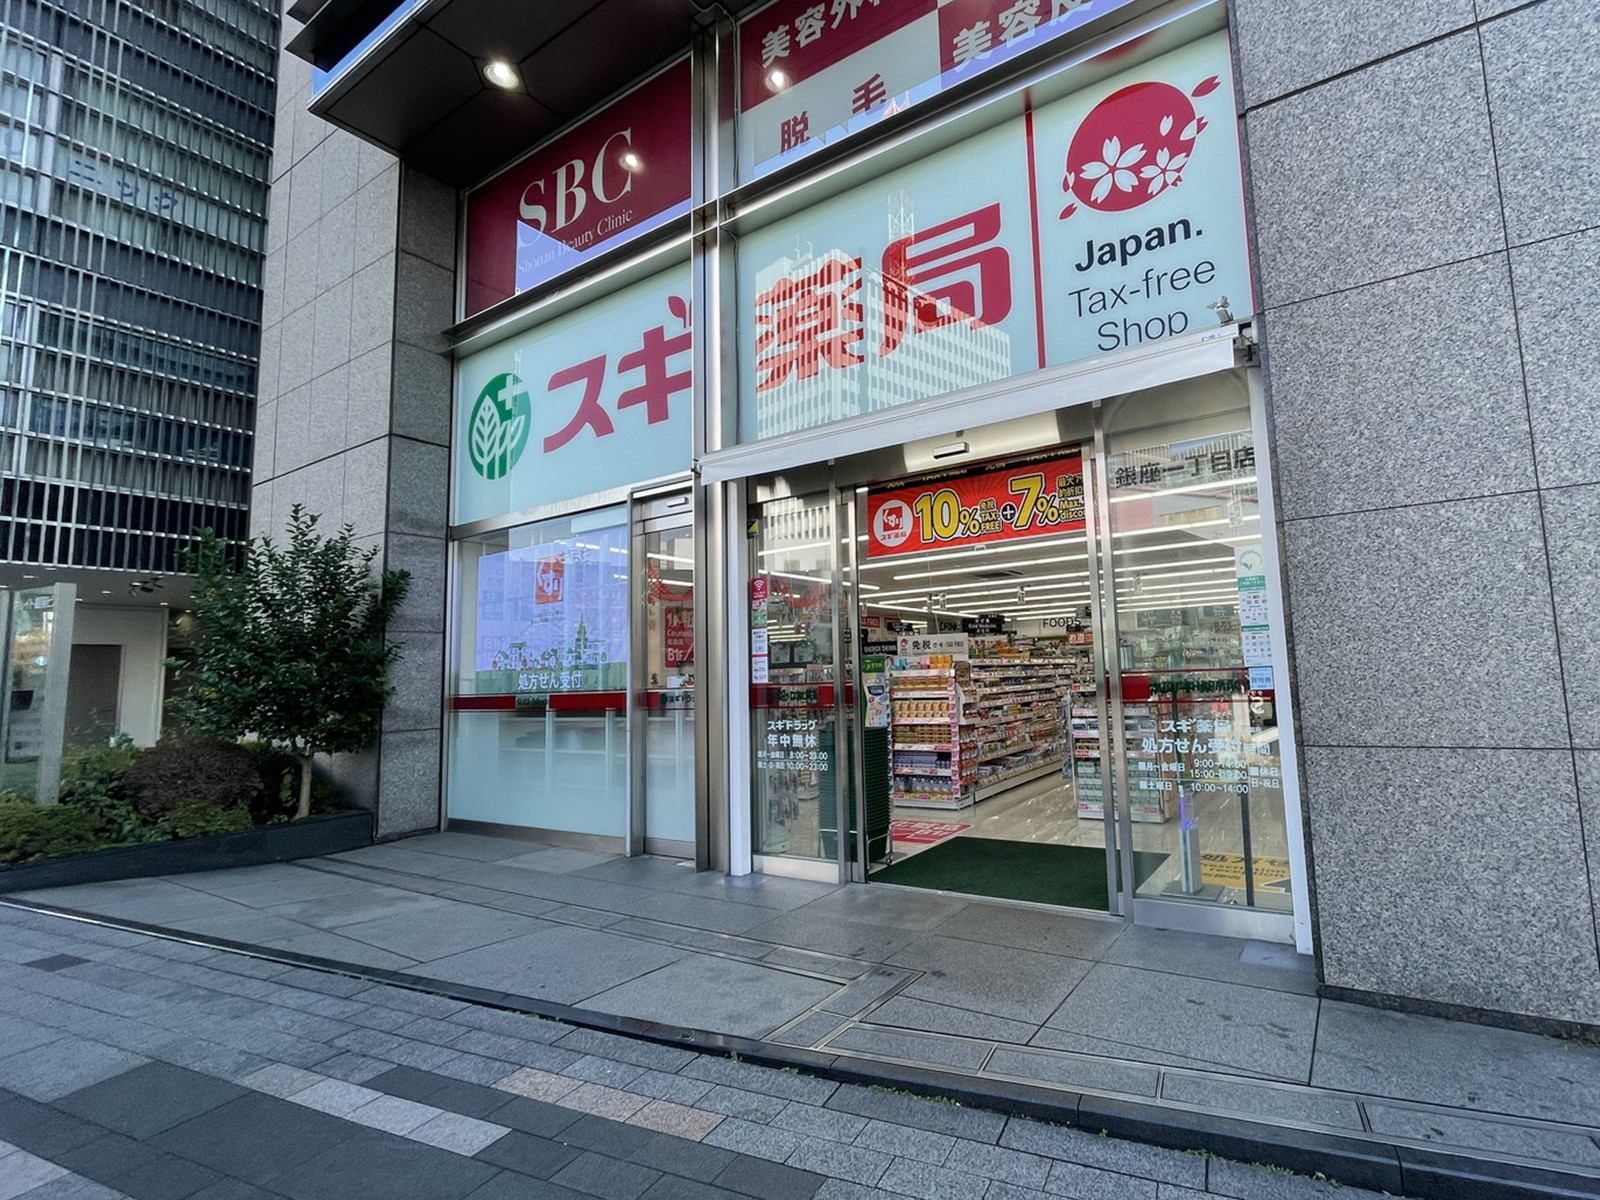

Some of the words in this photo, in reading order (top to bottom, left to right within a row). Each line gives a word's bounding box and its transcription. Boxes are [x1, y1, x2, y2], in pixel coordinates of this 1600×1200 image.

[517, 127, 632, 247] SBC
[518, 249, 556, 273] Shonan
[558, 228, 595, 257] Beauty
[597, 209, 633, 236] Clinic
[1074, 218, 1204, 272] Japan.
[1068, 260, 1217, 318] Tax-free
[543, 295, 692, 454] スギ
[755, 202, 1012, 389] 薬局
[1096, 307, 1190, 352] Shop
[915, 490, 981, 541] 10%
[981, 521, 1001, 532] FREE
[1043, 616, 1082, 628] FOODS
[518, 671, 583, 690] 処方せん受付
[767, 719, 818, 731] スギドラッグ
[1161, 718, 1232, 733] スギ薬局
[767, 733, 818, 748] 年中無休
[1142, 736, 1271, 756] 処方せん受付時間
[1191, 783, 1249, 794] 10:00~14:00
